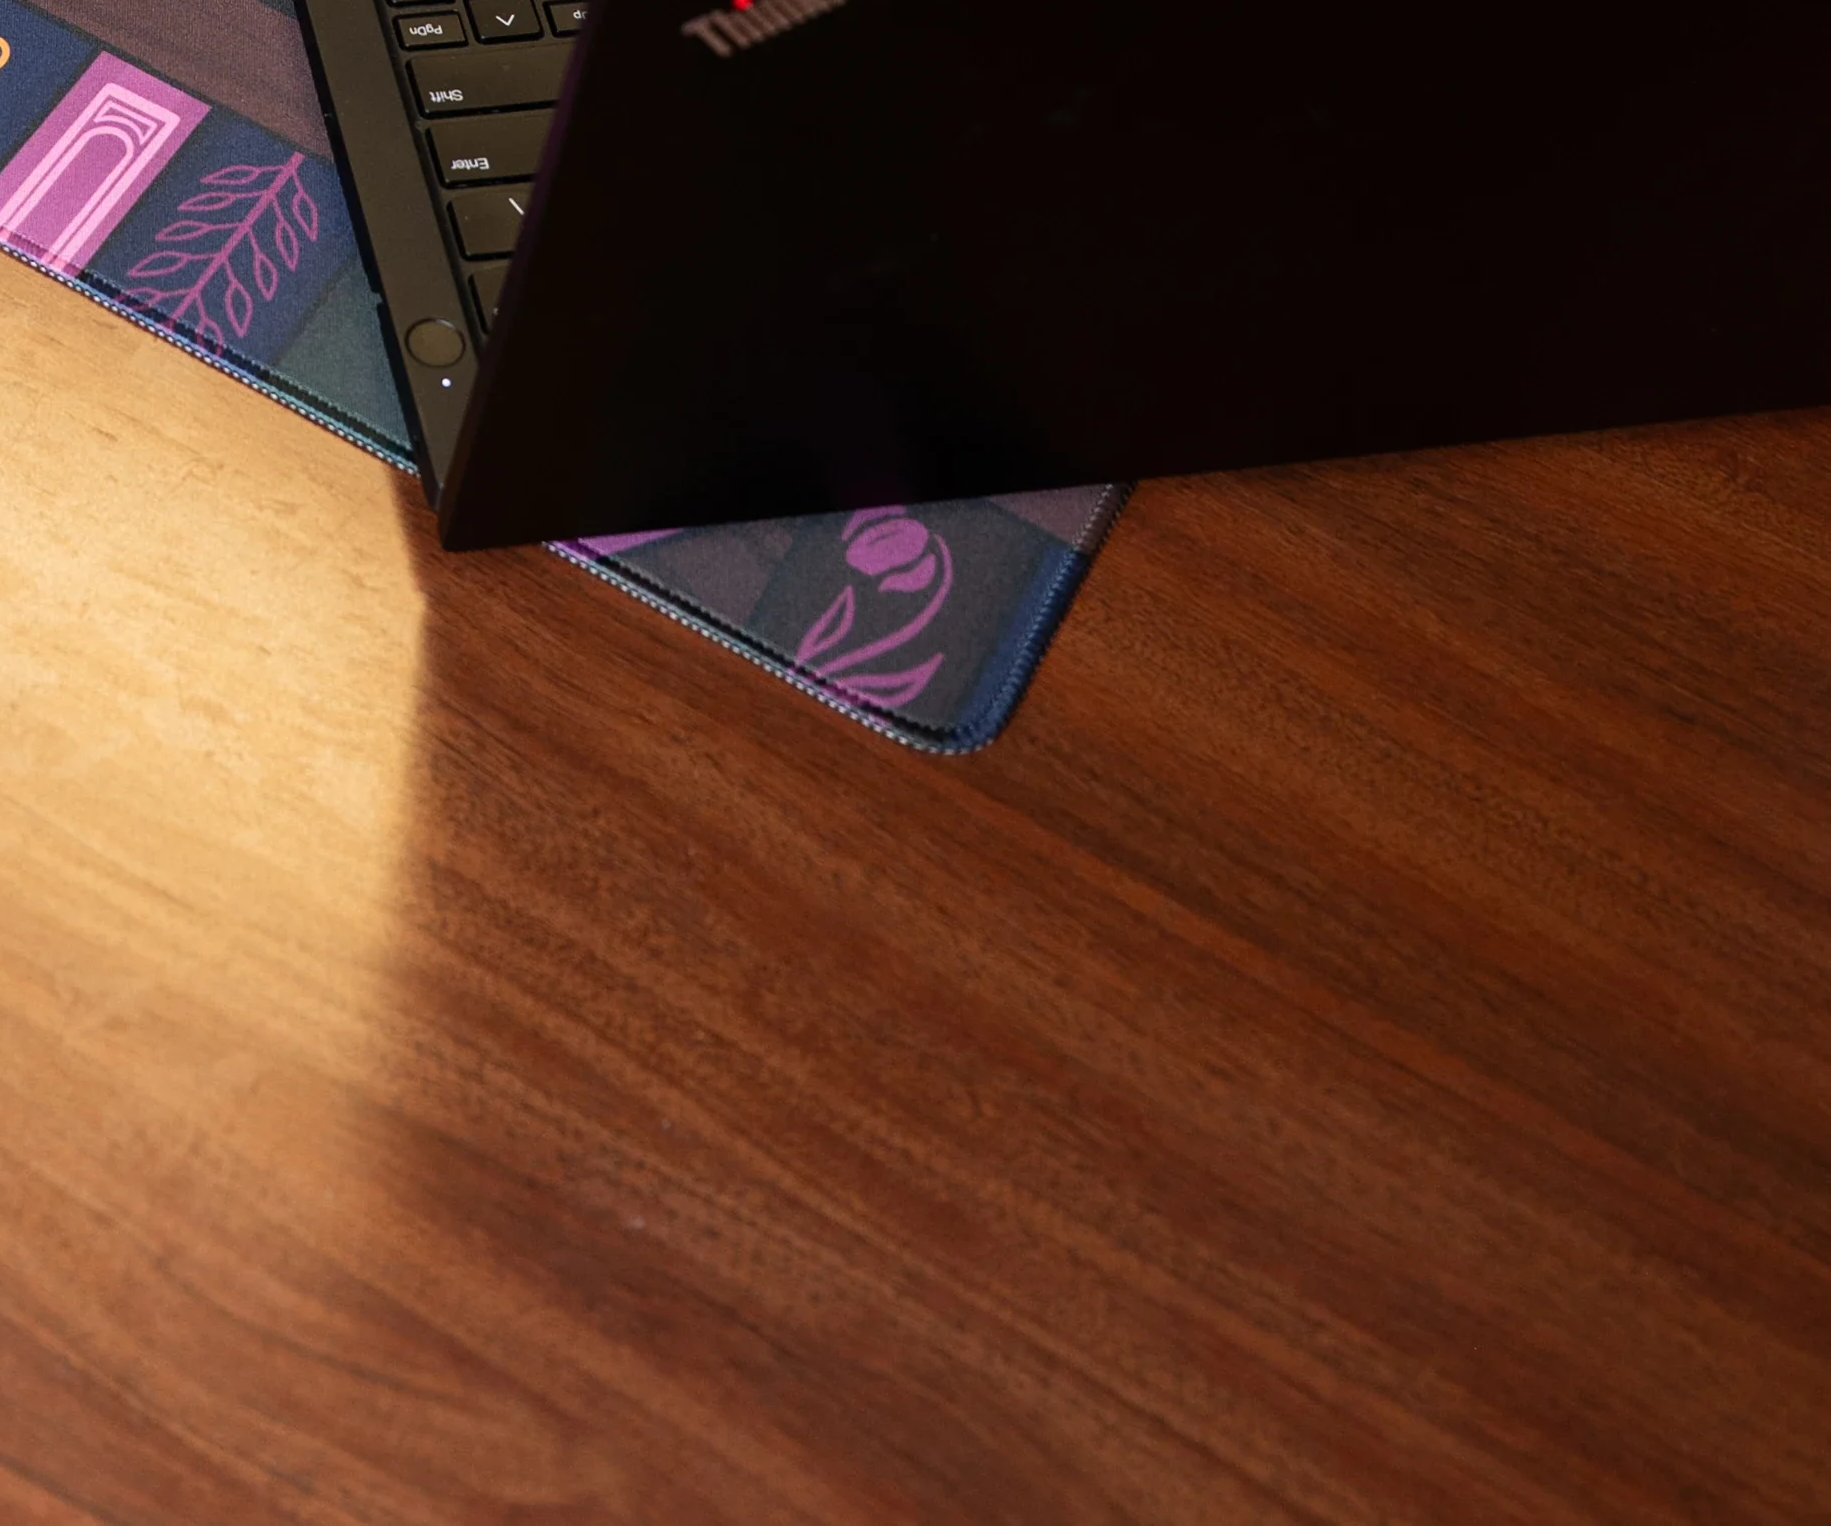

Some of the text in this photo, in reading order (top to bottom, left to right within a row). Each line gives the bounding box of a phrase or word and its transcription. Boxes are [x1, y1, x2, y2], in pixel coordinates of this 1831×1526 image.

[409, 24, 443, 36] PgDn
[429, 89, 464, 102] Shift
[451, 157, 490, 170] Enter
